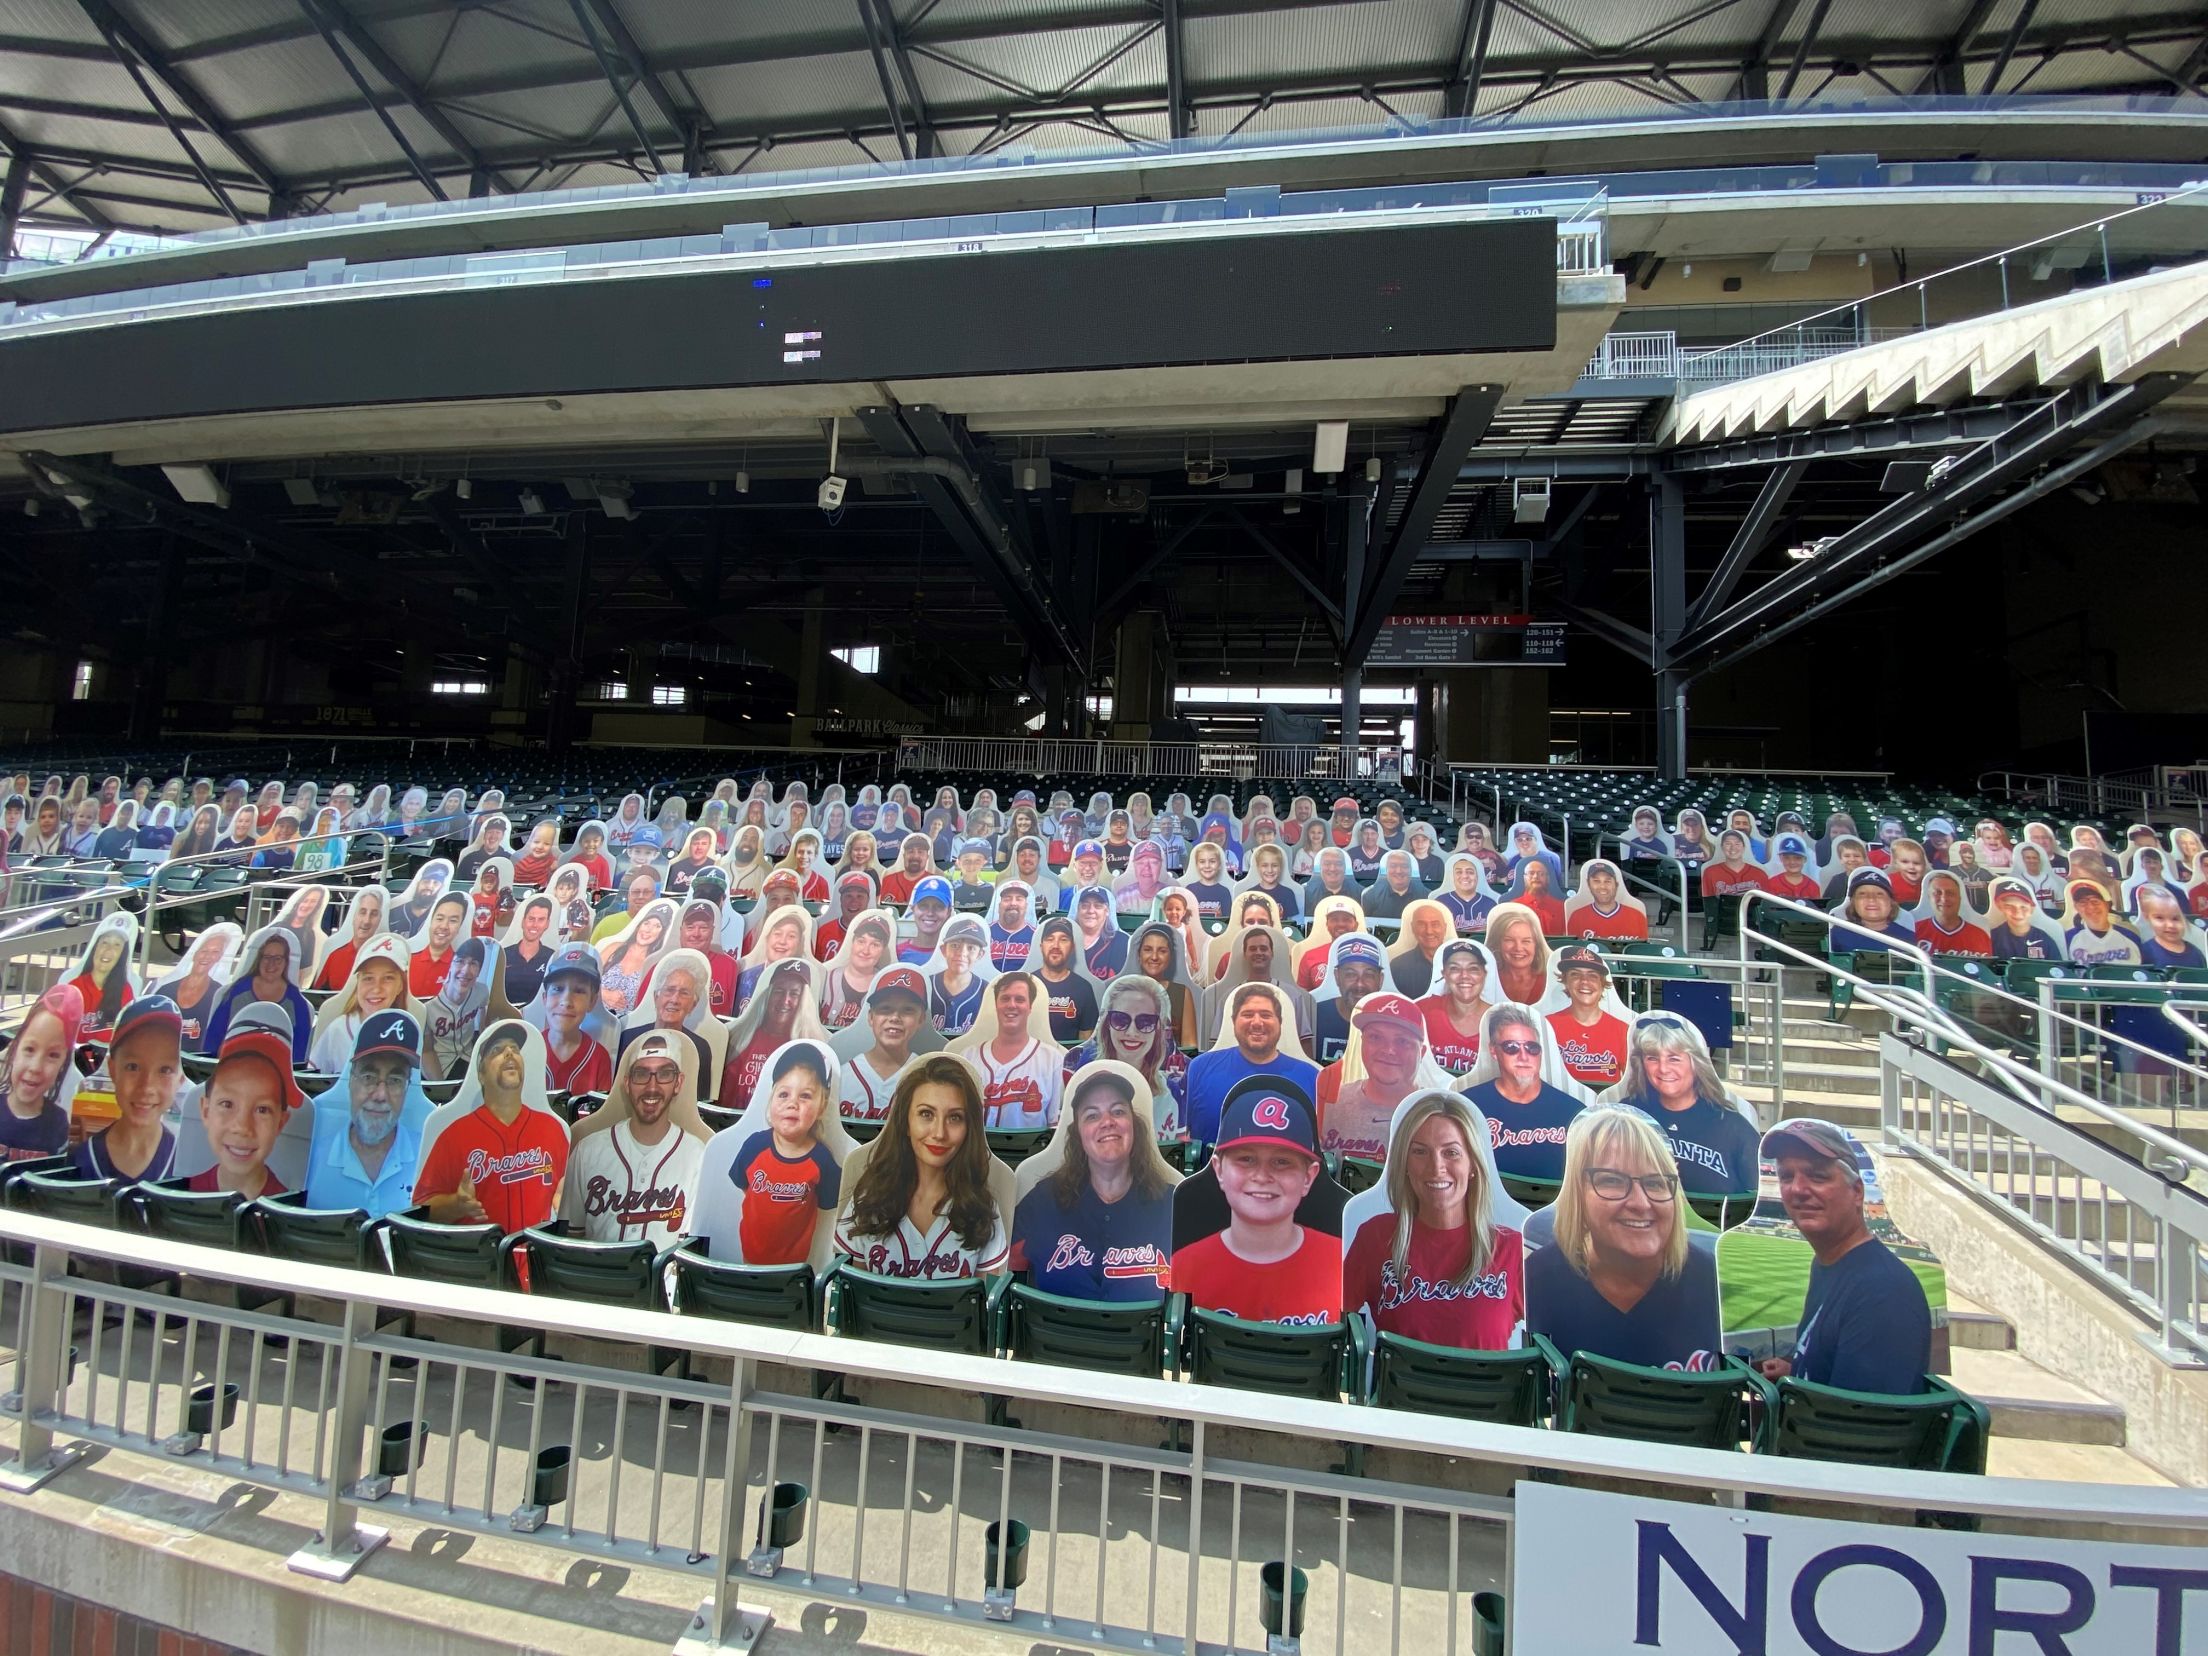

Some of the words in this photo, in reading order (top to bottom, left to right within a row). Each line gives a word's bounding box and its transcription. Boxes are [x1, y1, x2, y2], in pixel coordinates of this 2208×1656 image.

[961, 243, 980, 252] 318
[1391, 616, 1447, 625] LOWER
[1458, 616, 1510, 625] LEVEL
[816, 718, 881, 732] BALLPARK
[823, 844, 845, 855] RAVES
[307, 854, 323, 869] 98
[372, 938, 393, 951] A
[888, 974, 911, 987] A
[1377, 1000, 1400, 1015] A
[379, 1019, 404, 1041] A
[1444, 1045, 1478, 1060] ATLANT
[1564, 1040, 1587, 1053] Los
[745, 1060, 765, 1075] GIR
[1161, 1112, 1174, 1130] A
[1252, 1097, 1290, 1130] a
[1487, 1117, 1567, 1149] Braves
[467, 1146, 542, 1184] Braves
[1667, 1138, 1729, 1178] ANTA
[751, 1170, 810, 1194] Braves
[584, 1174, 678, 1217] Braves
[868, 1244, 960, 1280] Braves
[1377, 1259, 1509, 1315] Braves
